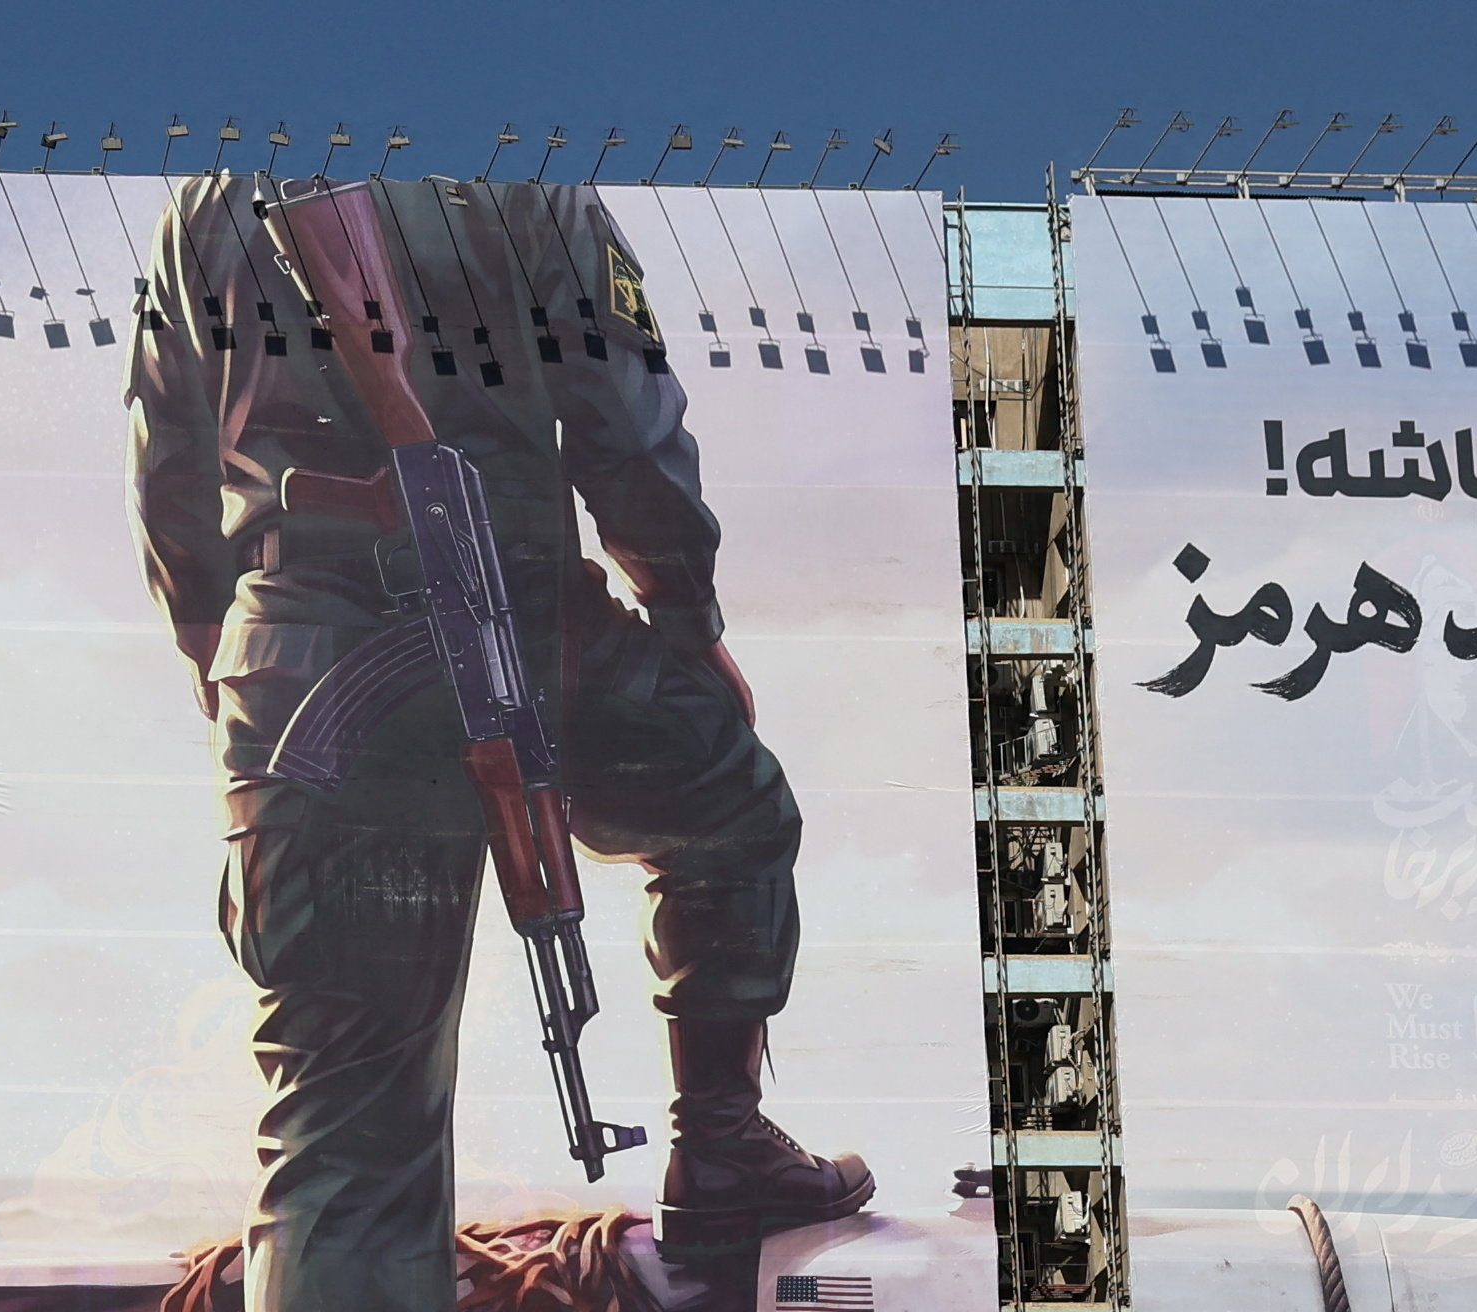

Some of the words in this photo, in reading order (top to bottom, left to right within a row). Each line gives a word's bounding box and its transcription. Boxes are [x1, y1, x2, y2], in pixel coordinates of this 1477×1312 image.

[1131, 542, 1422, 702] هرمز
[1384, 983, 1435, 1010] We
[1385, 1013, 1463, 1042] Must
[1387, 1042, 1453, 1070] Rise
